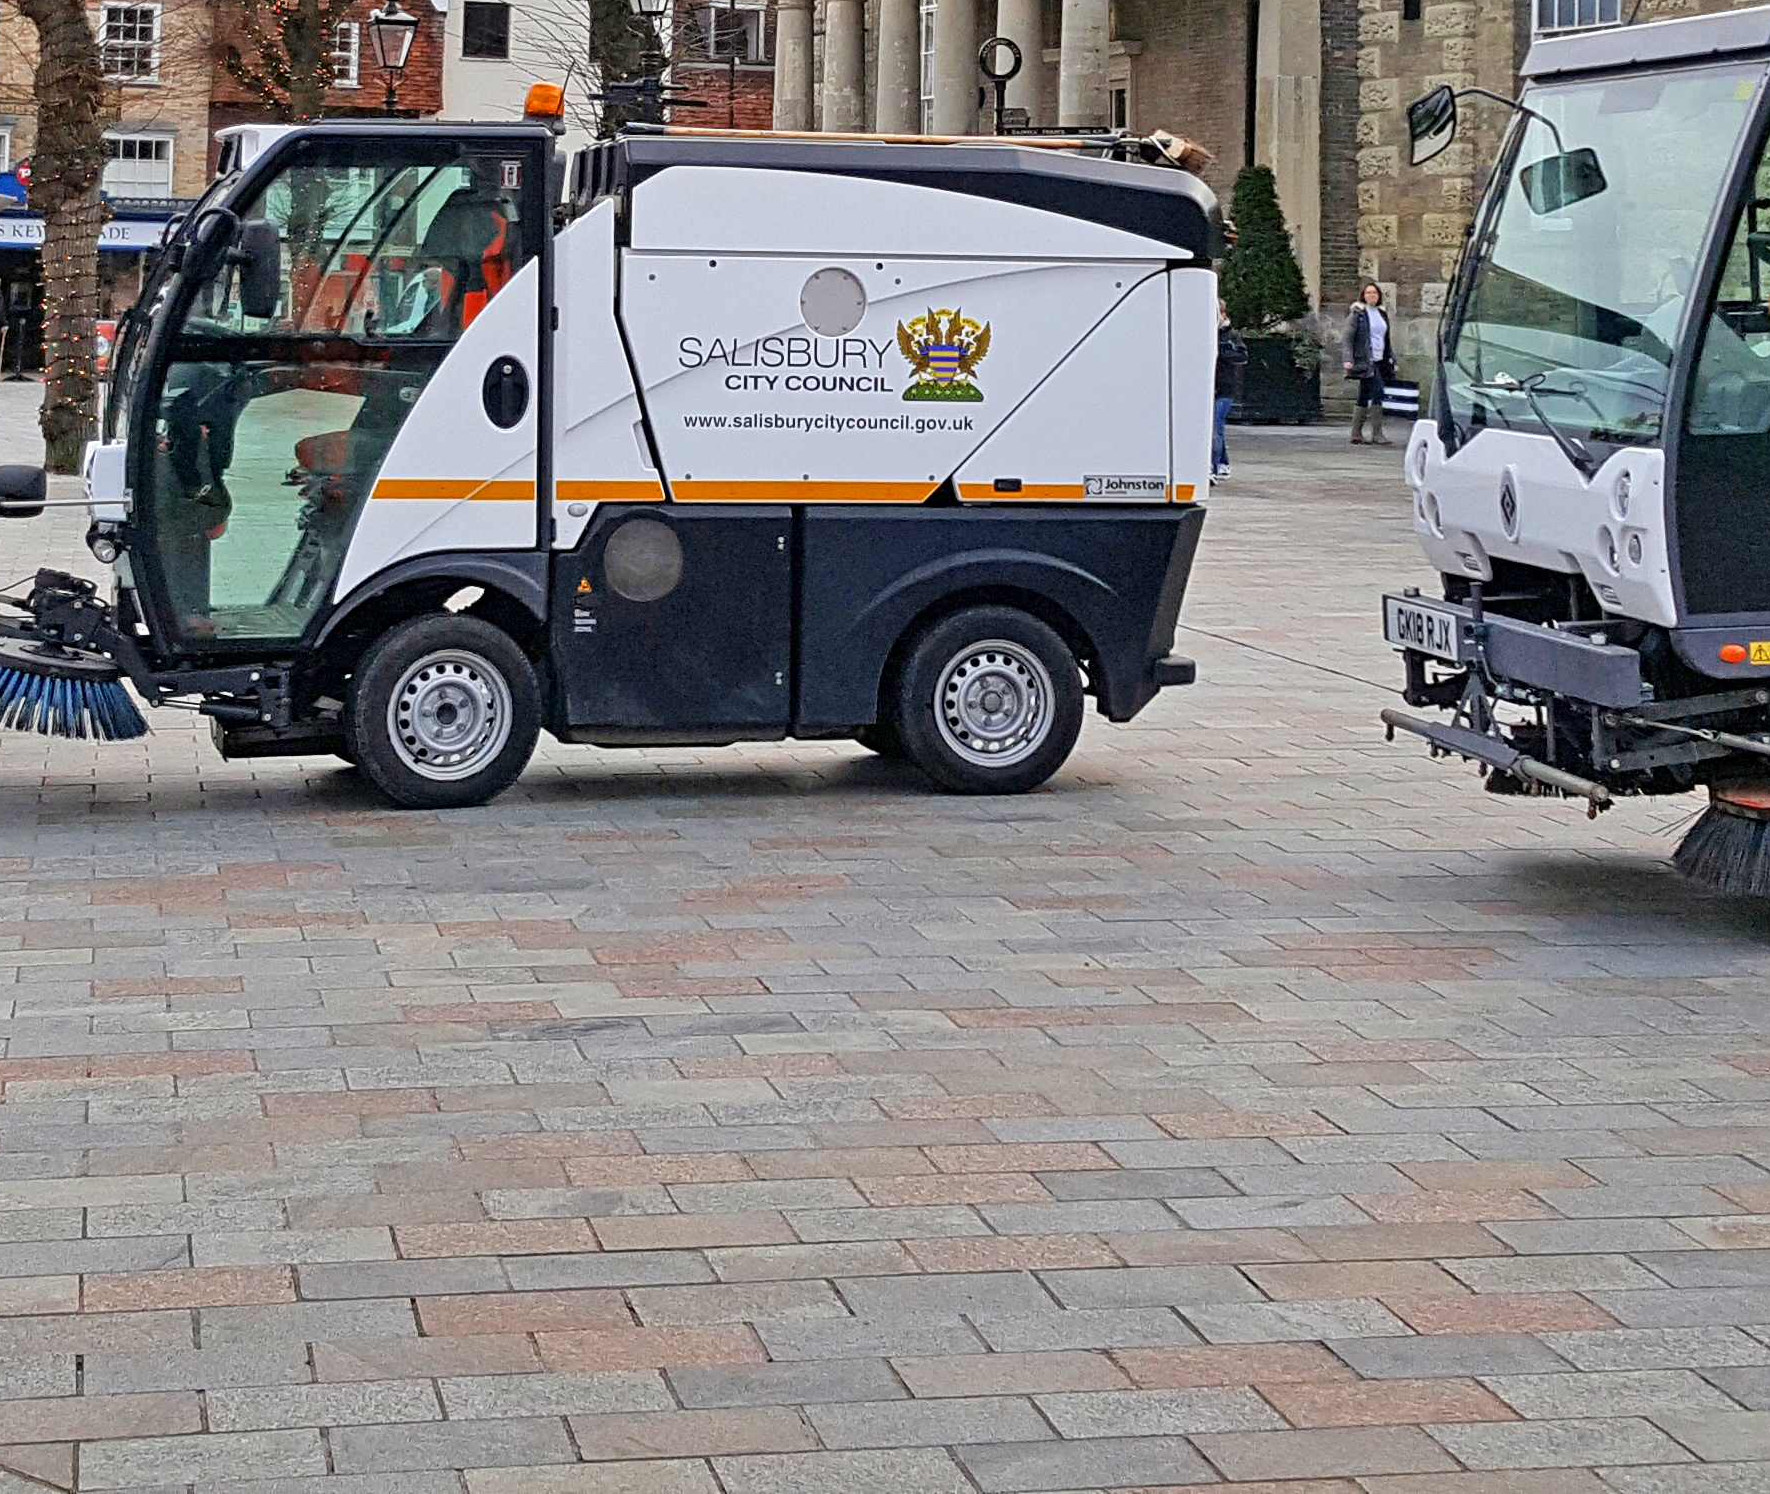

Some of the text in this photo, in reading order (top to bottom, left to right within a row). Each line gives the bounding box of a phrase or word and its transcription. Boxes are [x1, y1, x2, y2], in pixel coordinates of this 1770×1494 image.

[679, 337, 893, 368] SALISBURY
[725, 375, 893, 392] CITY COUNCIL
[684, 414, 974, 433] www.salisburycitycouncil.gov.uk
[1105, 478, 1164, 490] Johnston
[1397, 608, 1452, 652] GK18 RJX
